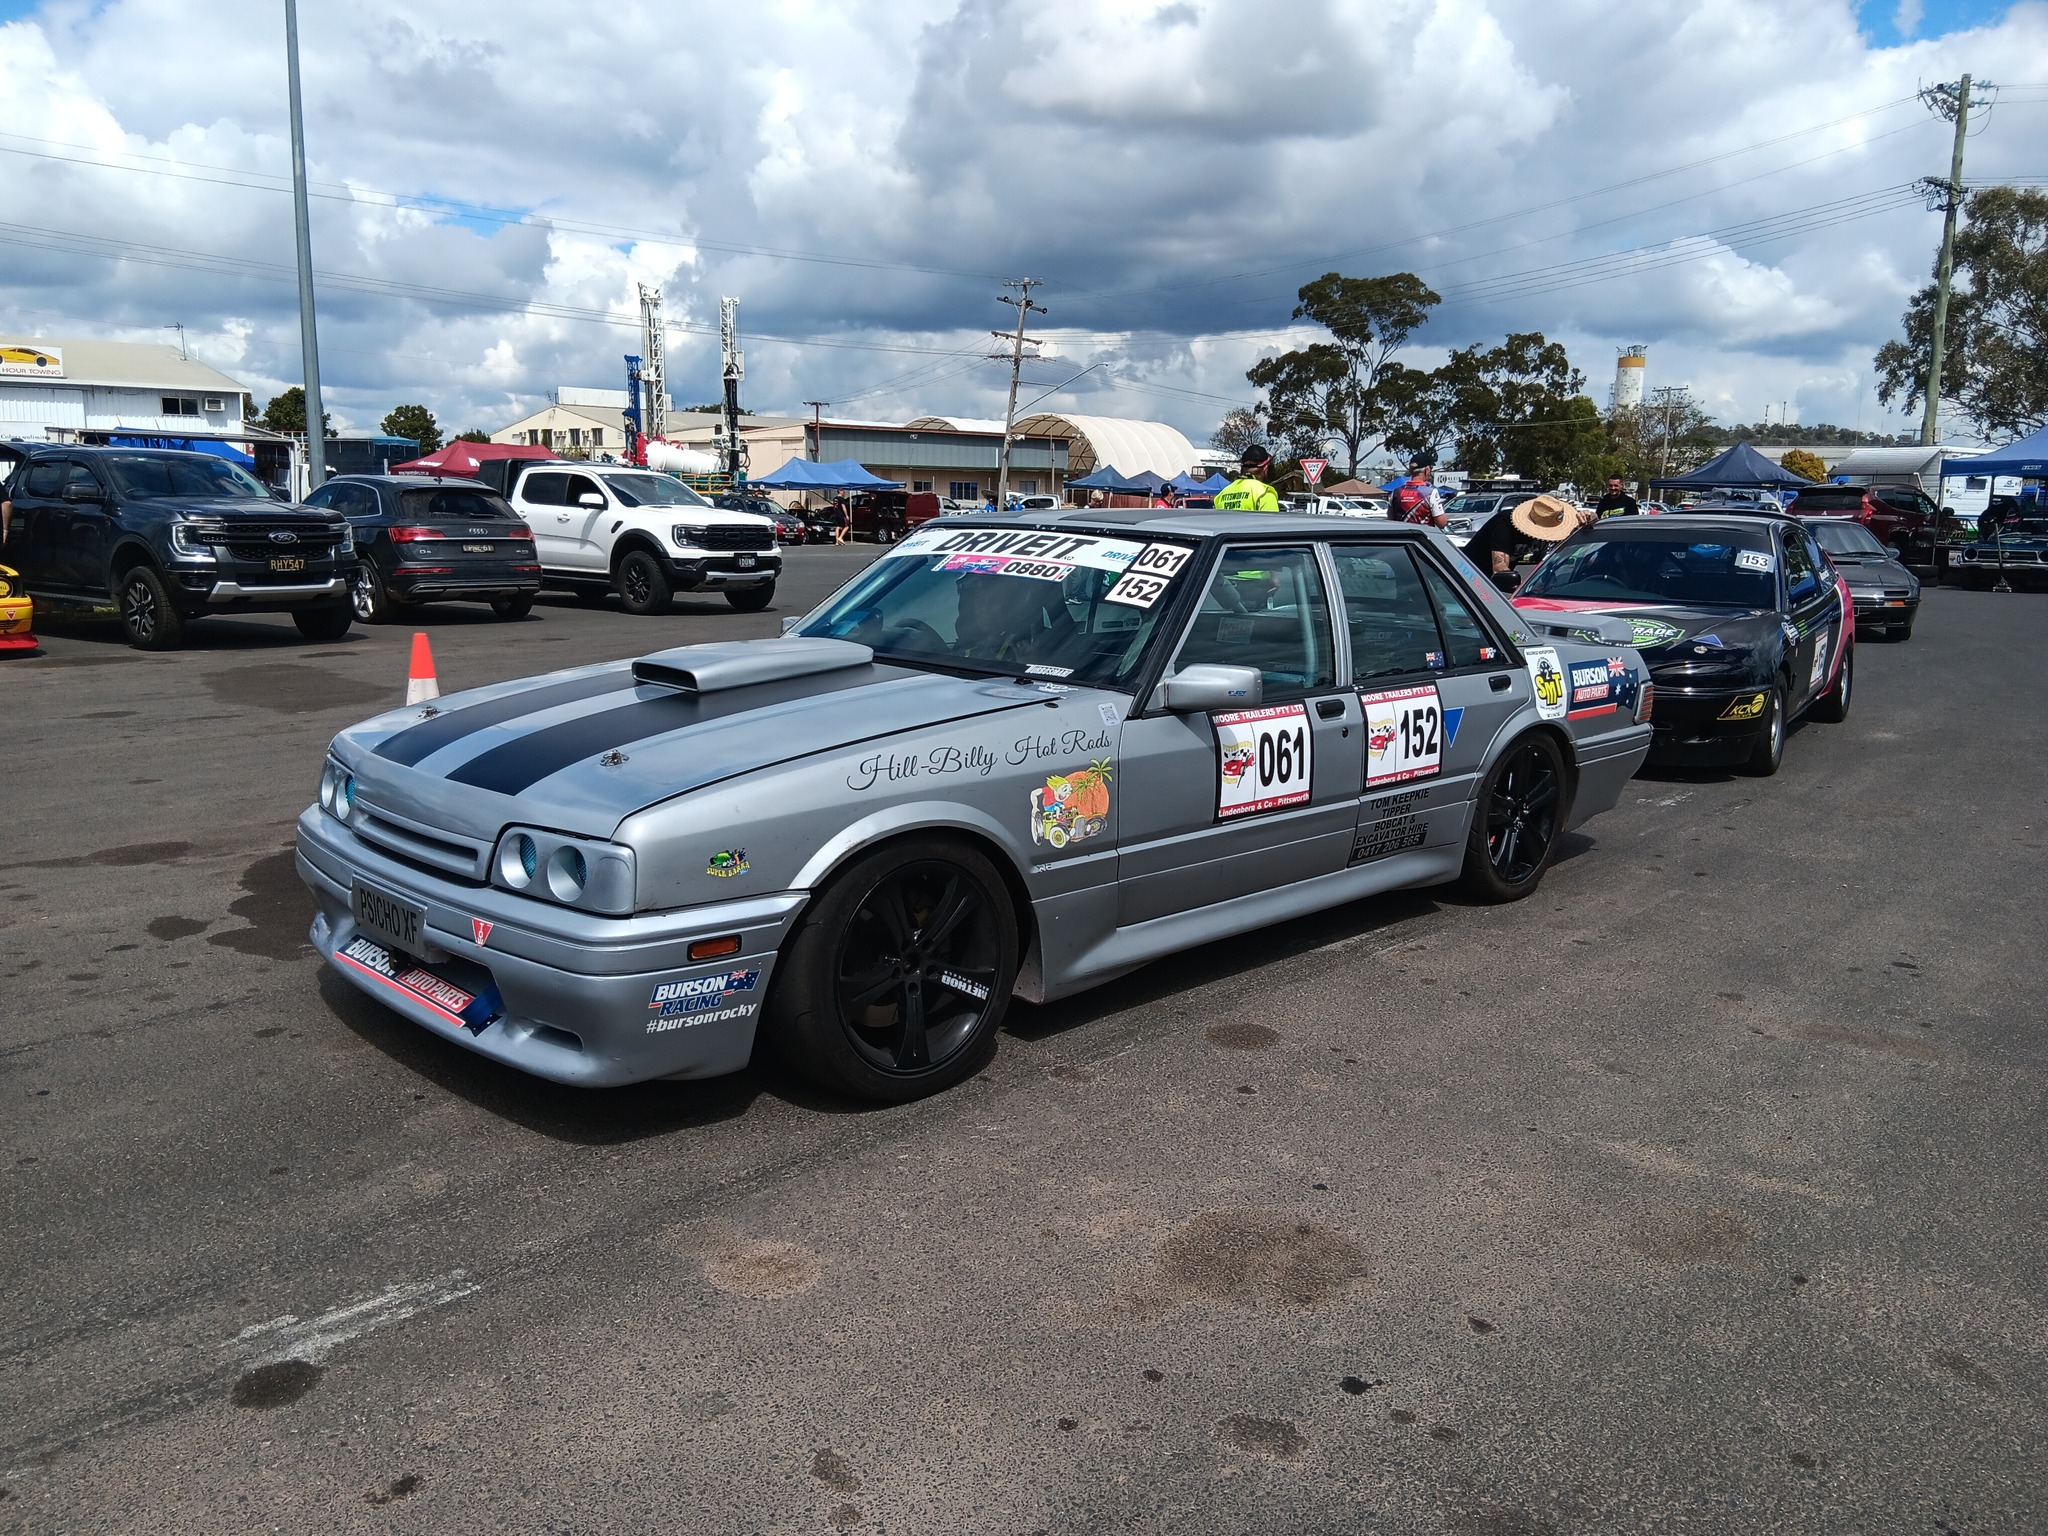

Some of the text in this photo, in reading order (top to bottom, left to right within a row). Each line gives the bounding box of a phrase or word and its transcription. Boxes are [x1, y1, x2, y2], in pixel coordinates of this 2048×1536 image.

[1221, 491, 1250, 502] PITTSWORTH
[931, 532, 1099, 559] DRIVEIT
[270, 560, 304, 569] RHY547
[1003, 562, 1060, 578] 0880
[1138, 548, 1187, 572] 061
[1743, 554, 1768, 567] 153
[1116, 577, 1163, 602] 152
[1572, 666, 1608, 687] BURSON
[1361, 685, 1436, 702] MOORE TRAILERS PTY LTD
[1535, 672, 1563, 705] SMT
[1576, 686, 1608, 700] AUTO PARTS
[1212, 703, 1304, 724] MOORE TRAILERS PTY LTD
[1400, 706, 1438, 759] 152
[846, 730, 1113, 791] Hill-Billy Hot Rods
[1259, 727, 1304, 787] 061
[1366, 776, 1396, 788] Lindenberg
[1413, 766, 1439, 778] Pittsworth
[1218, 802, 1256, 818] Lindenberg
[1264, 800, 1273, 808] Co
[1277, 793, 1310, 806] Pittsworth
[1370, 788, 1430, 810] TOM KEEPKIE
[1383, 804, 1411, 818] TIPPER
[1356, 823, 1429, 846] EXCAVATOR HIRE
[1374, 815, 1408, 832] BOBCAT
[1357, 834, 1420, 858] 0417 206 565
[360, 888, 417, 944] PSICHO XF
[402, 969, 470, 1009] AUTO PARTS
[655, 975, 728, 1001] BURSON
[941, 974, 988, 1000] METHOD
[659, 994, 722, 1016] RACING
[646, 1003, 757, 1034] #bursonrocky
